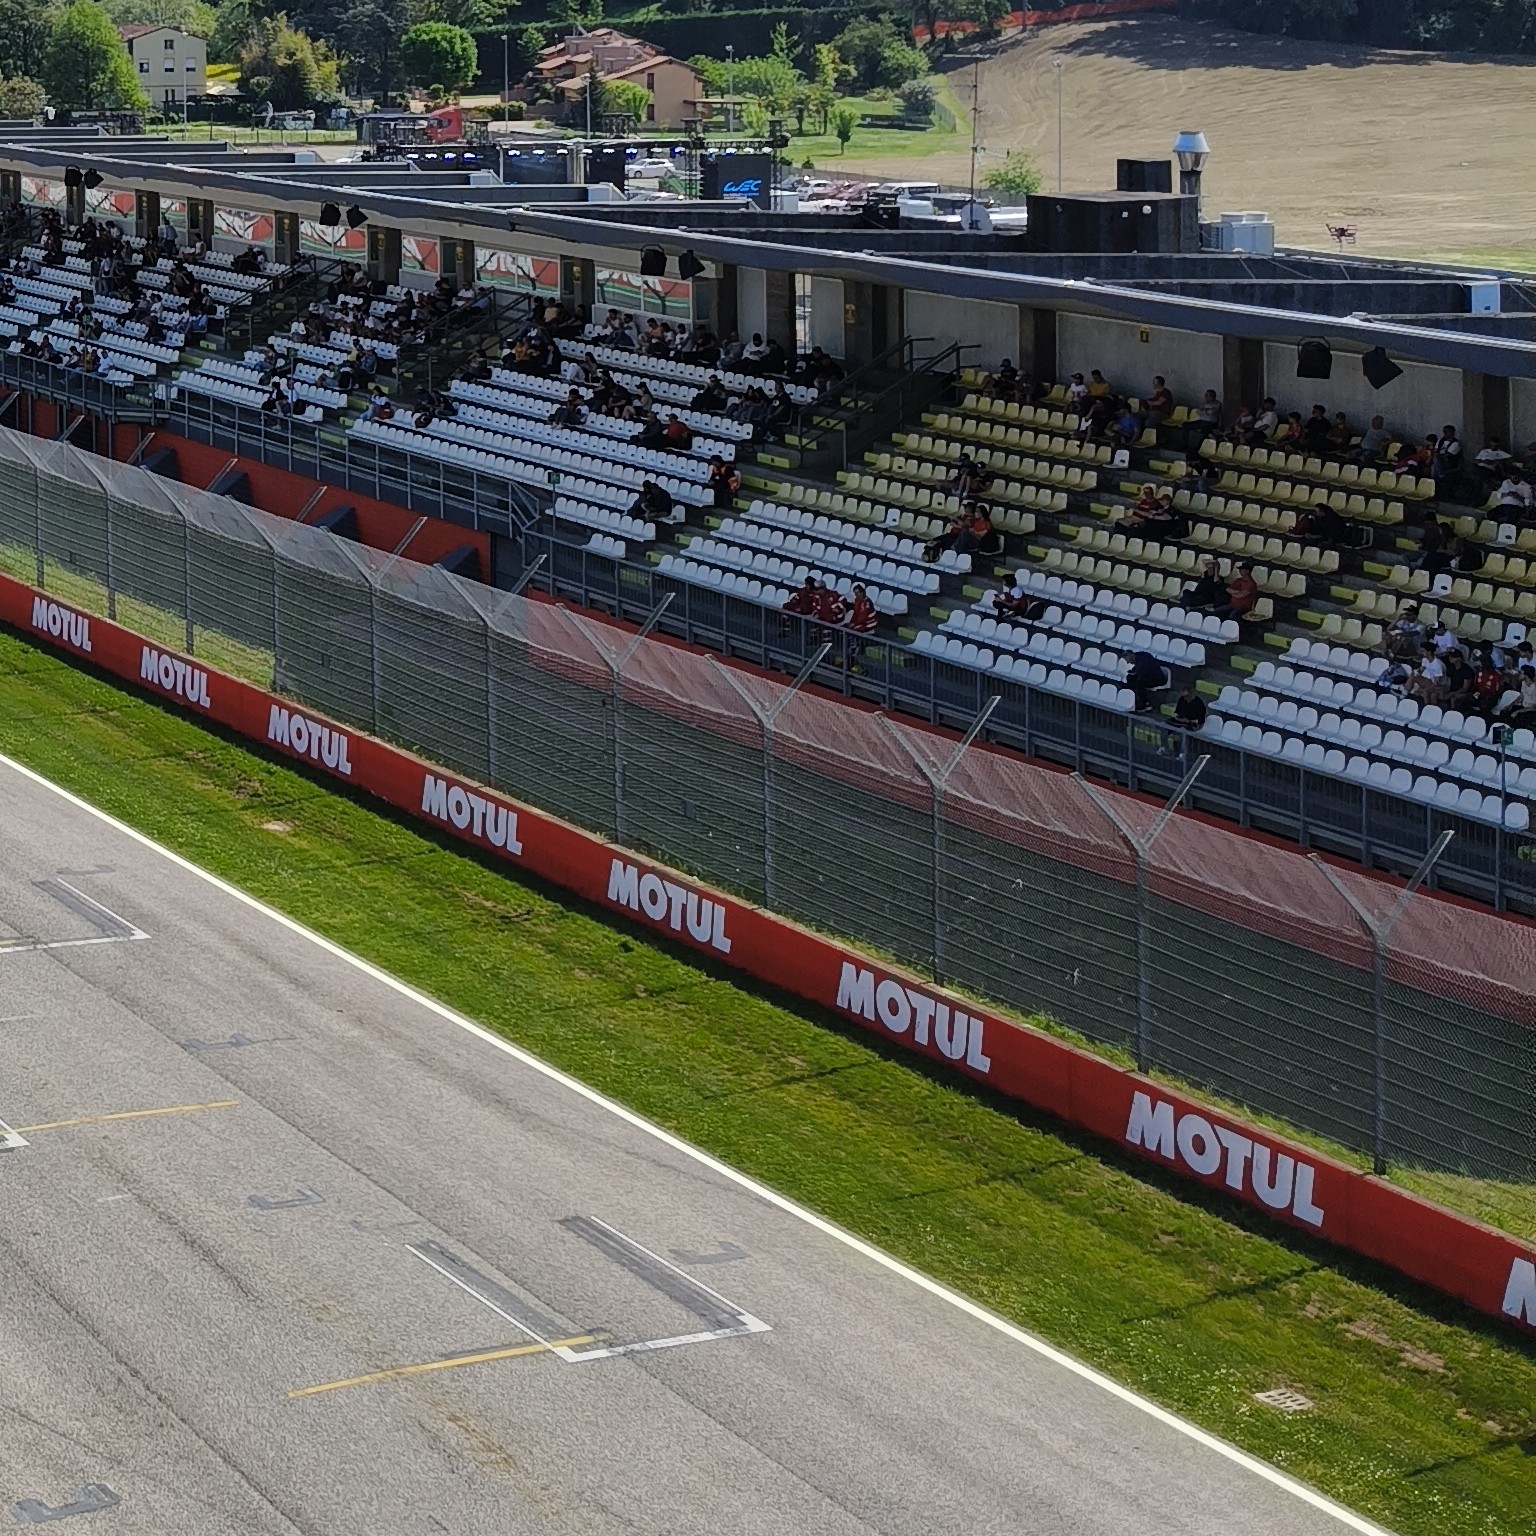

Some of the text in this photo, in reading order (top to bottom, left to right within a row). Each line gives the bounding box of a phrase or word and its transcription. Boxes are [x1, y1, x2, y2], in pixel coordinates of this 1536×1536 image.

[723, 179, 762, 192] WEC
[32, 596, 92, 652] MOTUL
[140, 646, 211, 708] MOTUL
[268, 704, 352, 775] MOTUL
[421, 774, 522, 856] MOTUL
[607, 859, 732, 954] MOTUL
[836, 961, 992, 1074] MOTUL
[1125, 1090, 1325, 1227] MOTUL
